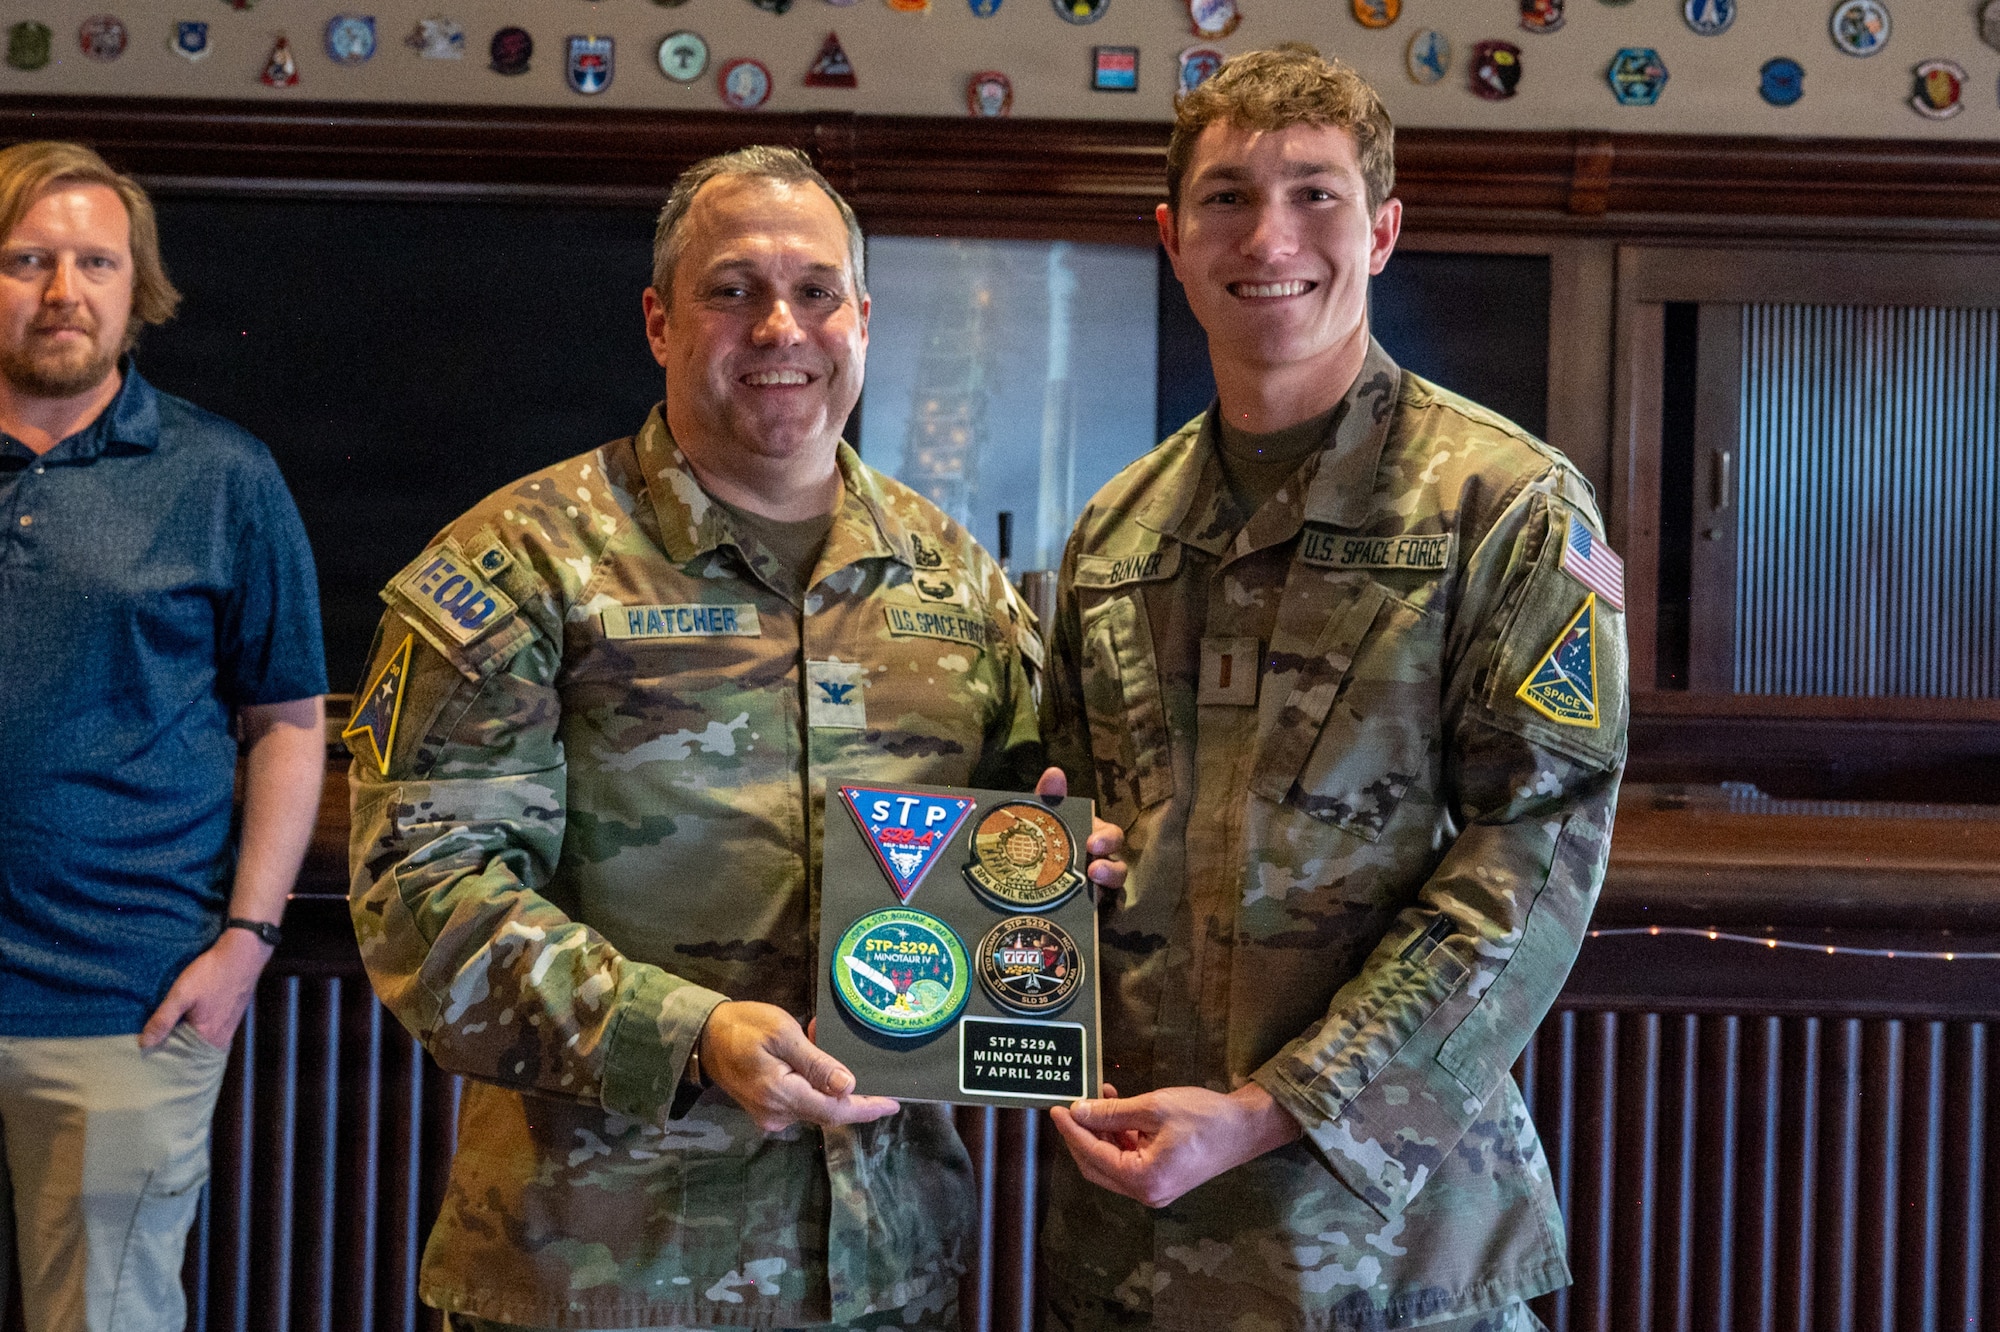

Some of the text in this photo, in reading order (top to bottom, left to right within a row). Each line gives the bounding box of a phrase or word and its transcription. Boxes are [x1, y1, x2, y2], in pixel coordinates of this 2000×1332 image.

[1304, 532, 1446, 566] U.S. SPACE FORCE
[413, 557, 496, 629] EOD
[628, 607, 738, 634] HATCHER
[891, 608, 918, 631] U.S.
[916, 612, 958, 637] SPACE
[390, 663, 401, 677] 30
[1543, 686, 1581, 709] SPACE
[871, 797, 947, 827] STP
[878, 827, 934, 846] S29-A
[993, 883, 1016, 898] CIVIL
[1018, 886, 1058, 900] ENGINEER
[1058, 876, 1071, 889] SQ
[1004, 918, 1051, 931] STP-S29A
[865, 939, 940, 956] STP-S29A
[1060, 936, 1073, 952] NGC
[874, 953, 921, 964] MINOTAUR
[992, 979, 1007, 993] STP
[1021, 996, 1038, 1004] SLD
[989, 1036, 1057, 1051] STP S29A
[973, 1050, 1073, 1066] MINOTAUR IV
[974, 1065, 1071, 1081] 7 APRIL 2026
